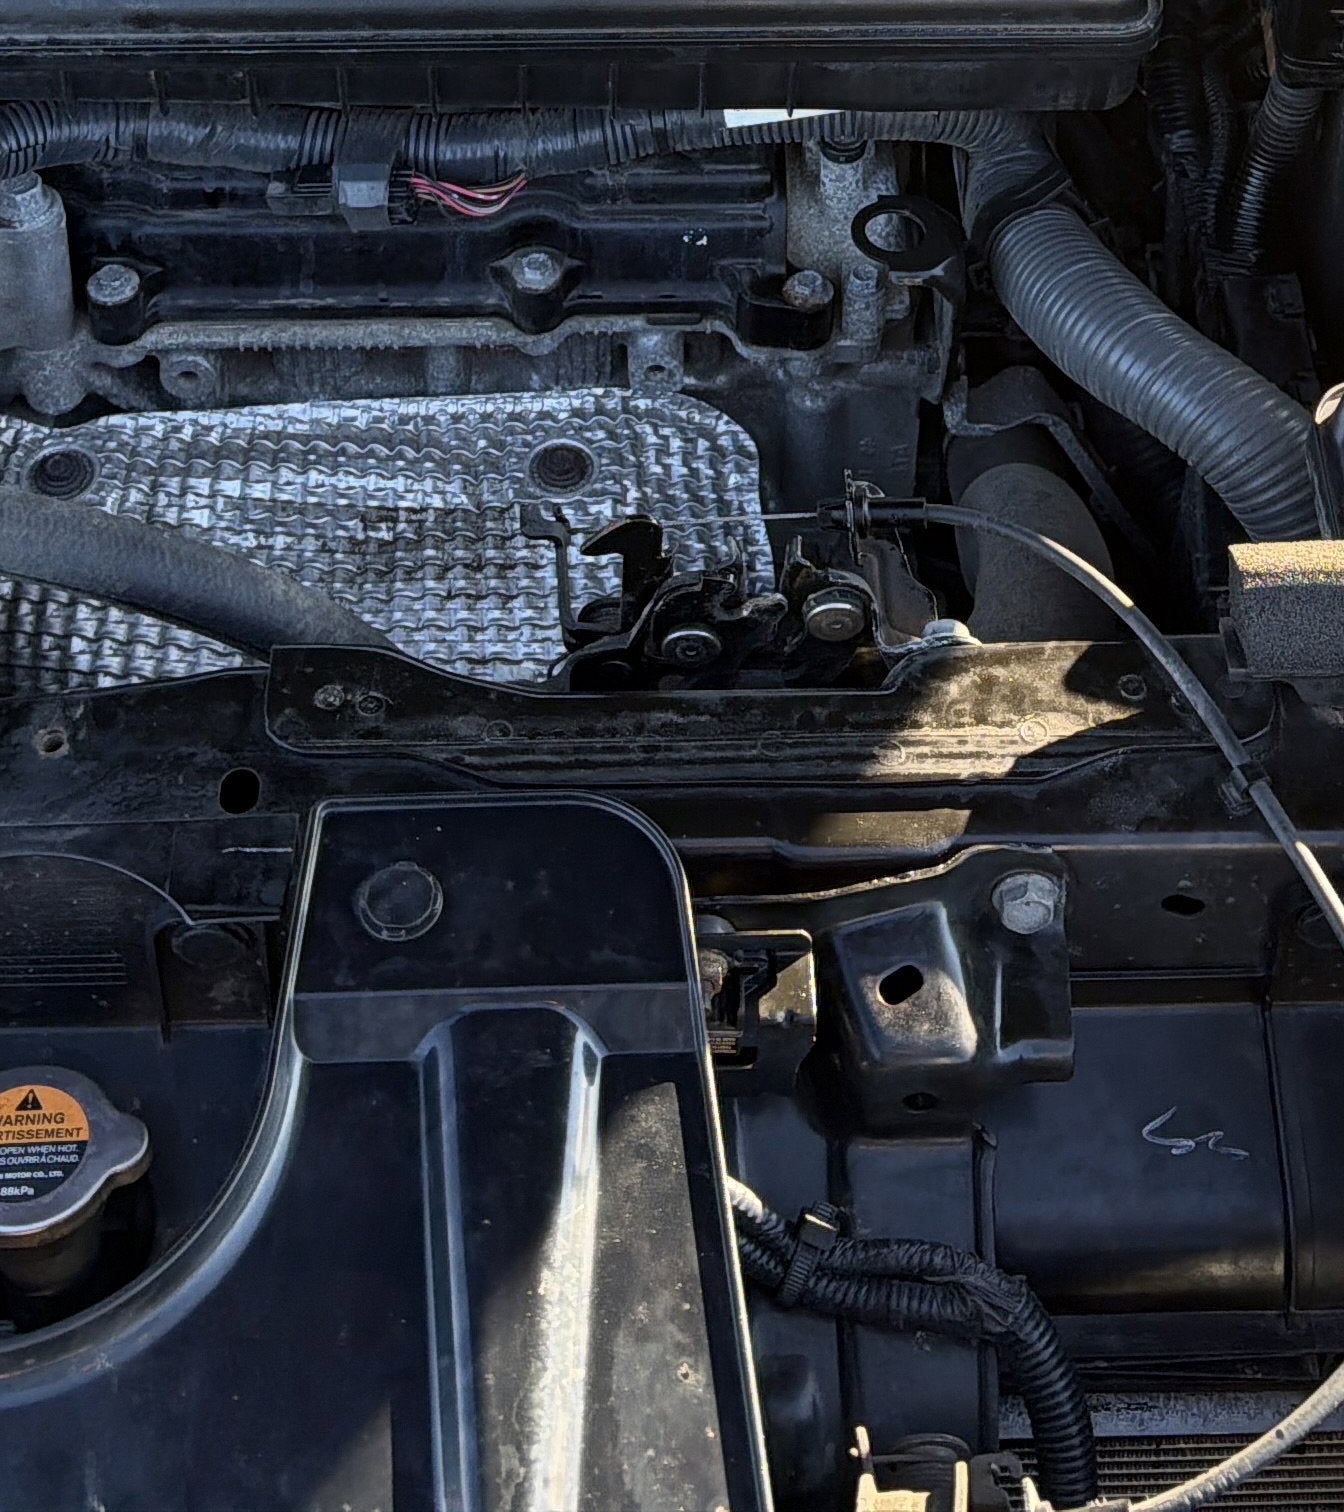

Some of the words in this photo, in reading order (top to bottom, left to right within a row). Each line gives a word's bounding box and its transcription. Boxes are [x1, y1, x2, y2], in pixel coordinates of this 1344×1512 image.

[0, 1146, 25, 1156] OPEN
[27, 1145, 56, 1155] WHEN
[58, 1144, 78, 1152] HOT.
[7, 1156, 39, 1165] OUVRIR
[47, 1154, 79, 1163] CHAUD.
[5, 1171, 32, 1179] MOTOR
[0, 1186, 34, 1196] 88kPa
